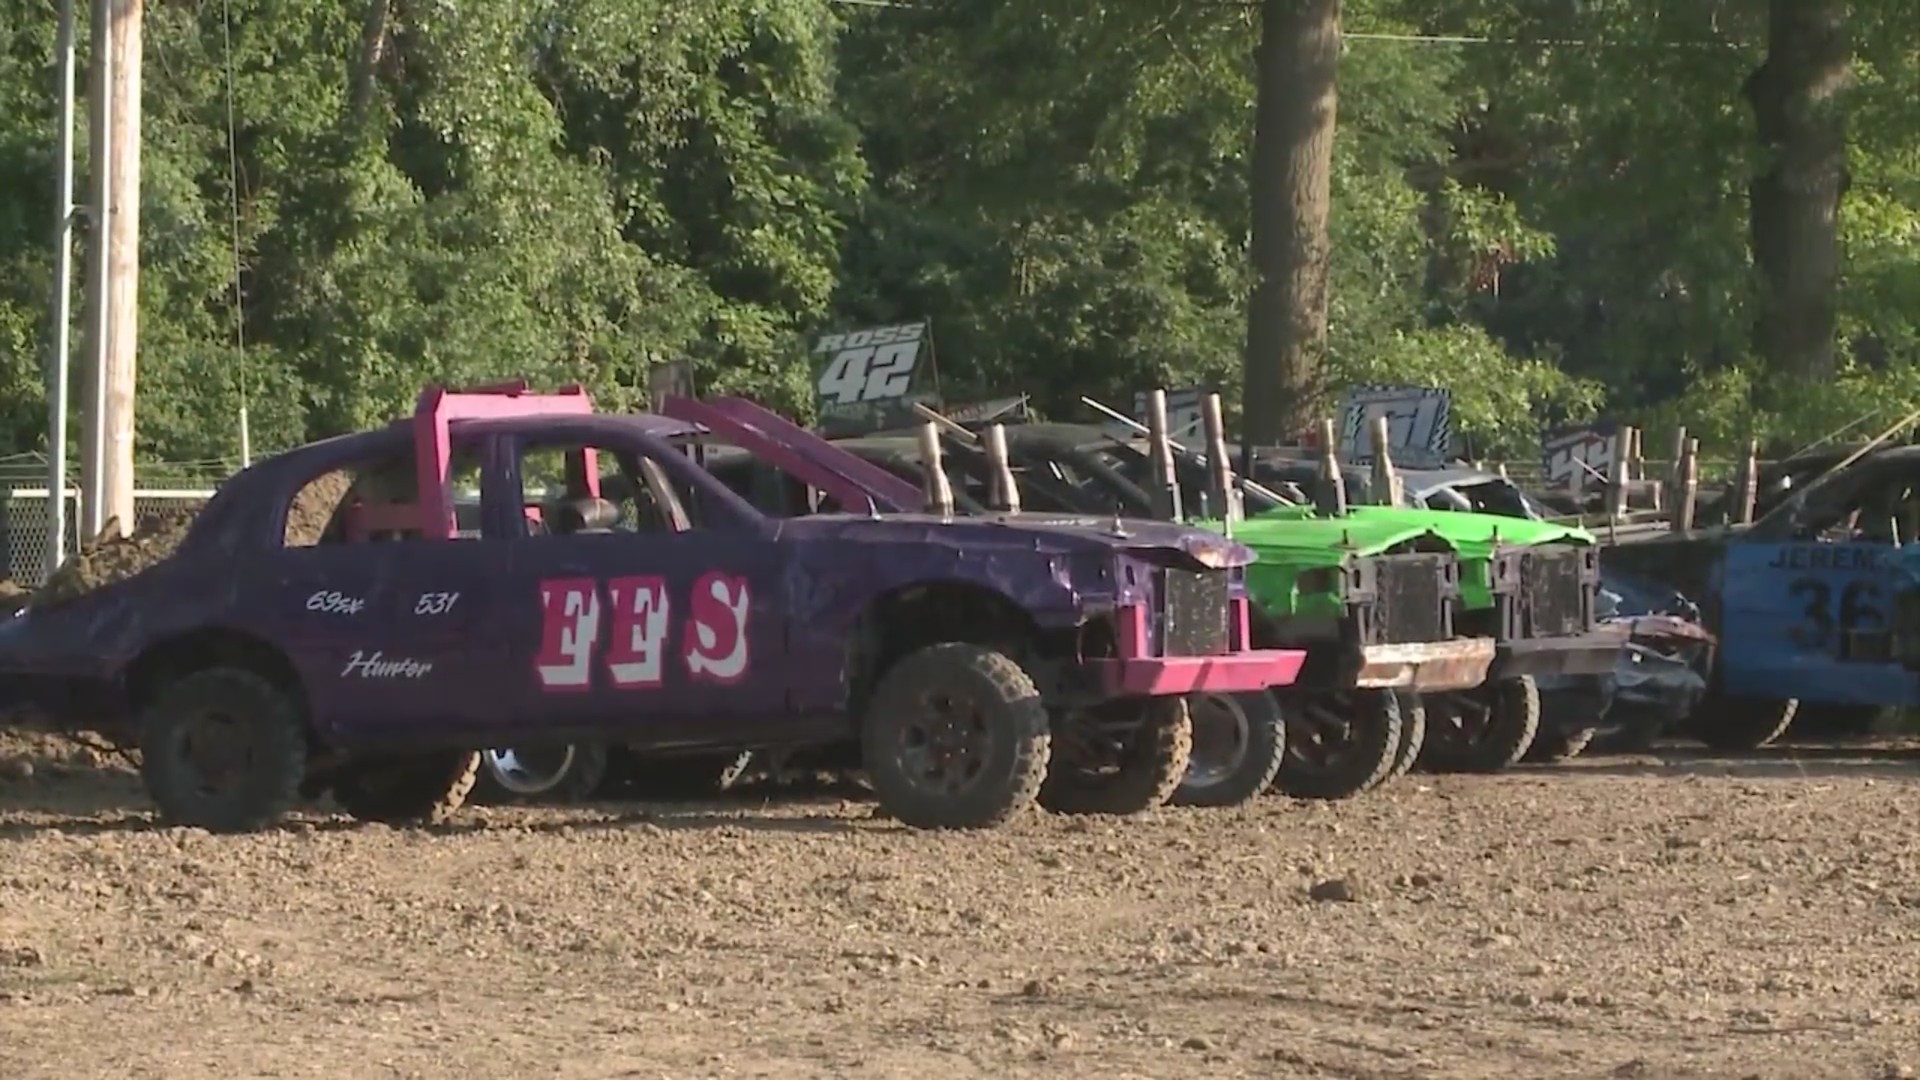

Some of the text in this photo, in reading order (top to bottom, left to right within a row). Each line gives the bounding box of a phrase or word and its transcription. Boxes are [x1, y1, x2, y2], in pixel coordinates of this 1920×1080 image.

[813, 322, 925, 353] ROSS
[818, 341, 920, 404] 42
[414, 592, 459, 614] 531
[340, 651, 432, 677] Hunter
